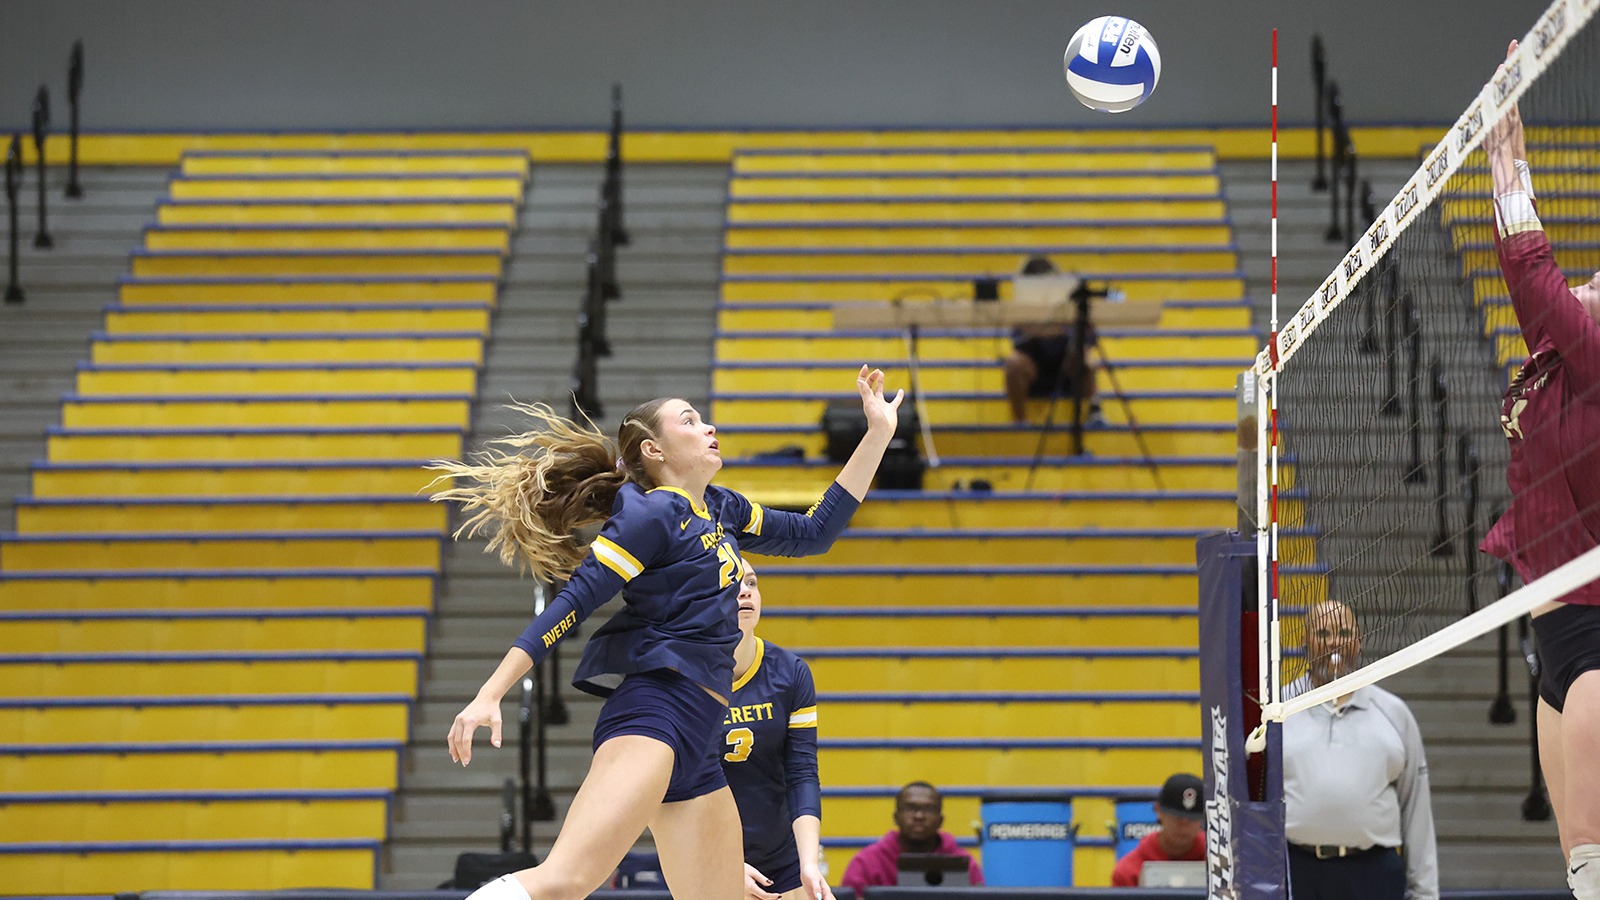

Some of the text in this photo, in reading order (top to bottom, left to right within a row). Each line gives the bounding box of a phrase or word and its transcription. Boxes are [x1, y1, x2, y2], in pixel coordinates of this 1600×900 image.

[717, 542, 744, 589] 21
[723, 702, 773, 725] RETT
[724, 727, 754, 762] 3
[1207, 804, 1222, 900] VOLL
